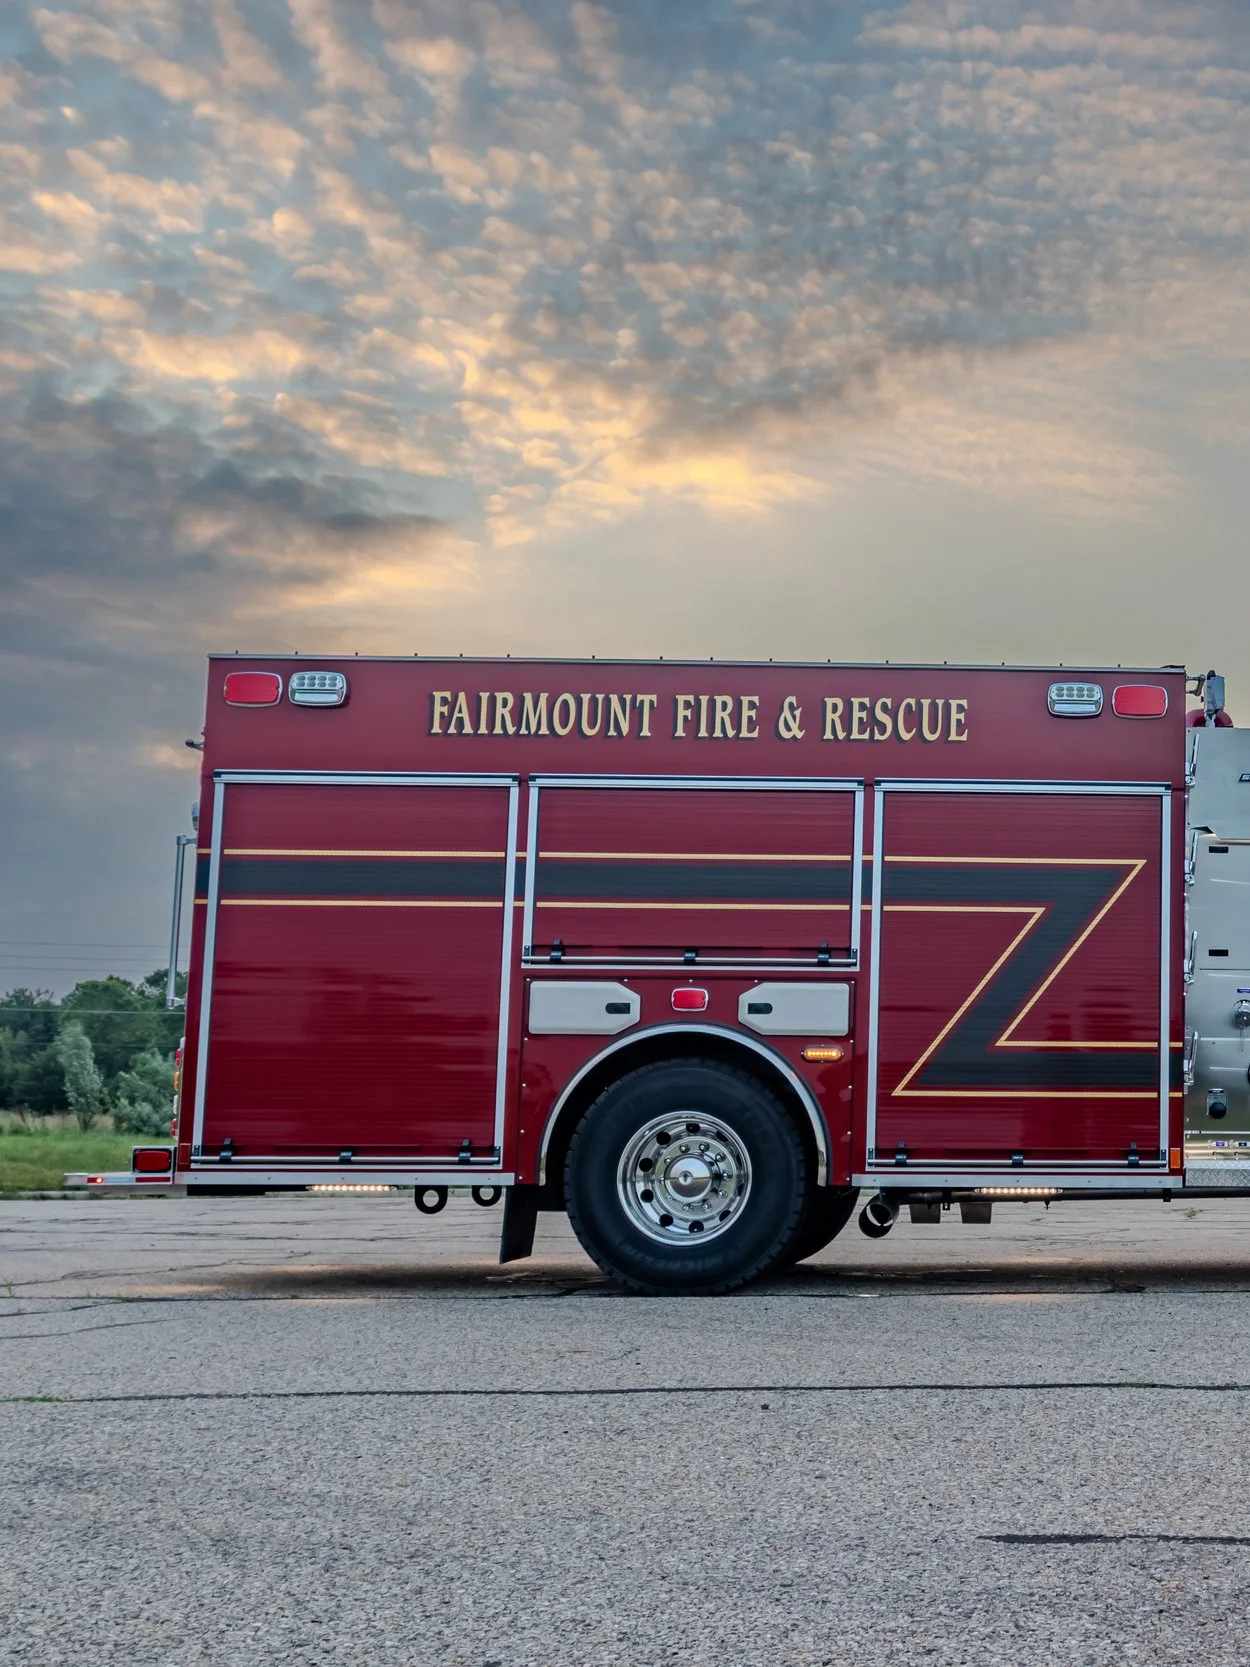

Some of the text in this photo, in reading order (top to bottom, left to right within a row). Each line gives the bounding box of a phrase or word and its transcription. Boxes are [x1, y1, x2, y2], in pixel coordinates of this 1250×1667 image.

[429, 691, 968, 741] FAIRMOUNT FIRE & RESCUE
